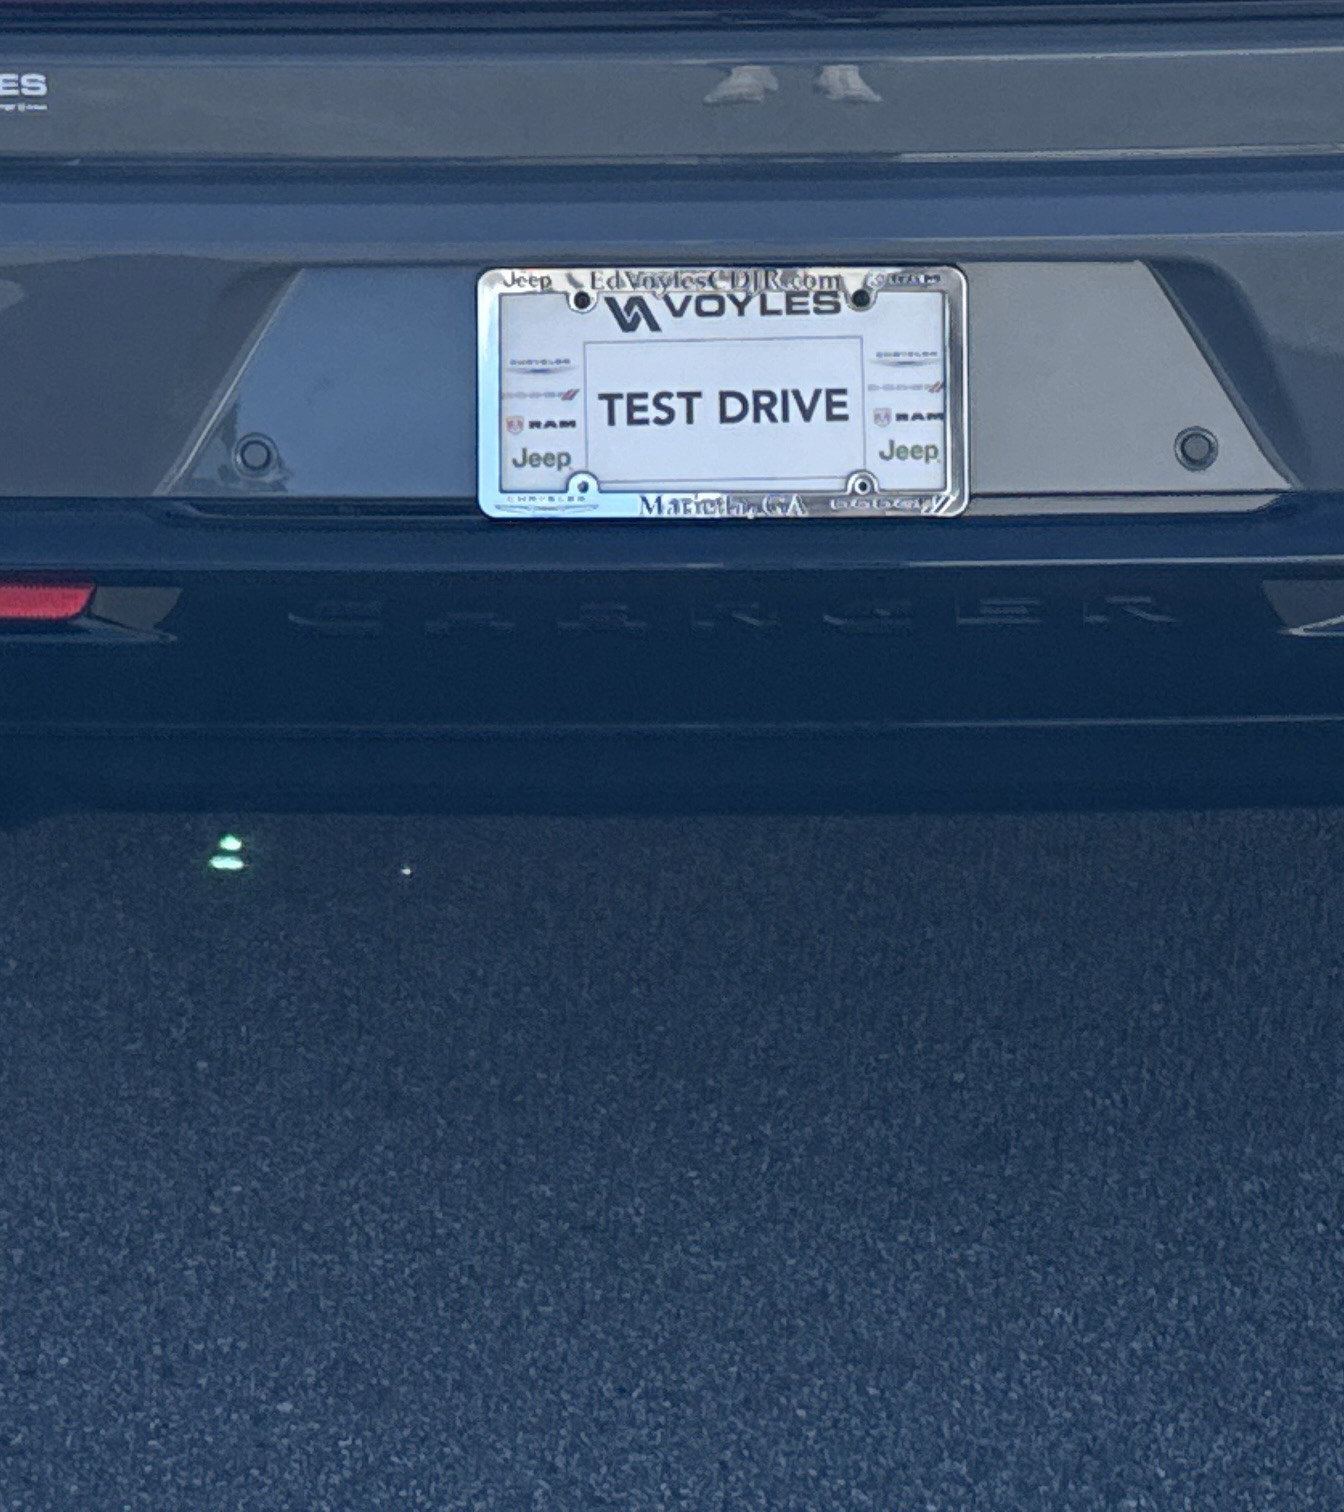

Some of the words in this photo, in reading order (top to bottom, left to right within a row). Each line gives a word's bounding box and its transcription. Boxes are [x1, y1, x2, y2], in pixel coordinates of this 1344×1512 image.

[503, 270, 553, 291] Jeep
[662, 290, 842, 318] VOYLES
[597, 390, 703, 427] TEST
[718, 387, 850, 425] DRIVE
[895, 412, 944, 422] RAM
[528, 420, 576, 429] RAM
[512, 447, 572, 472] Jeep
[878, 439, 939, 464] Jeep
